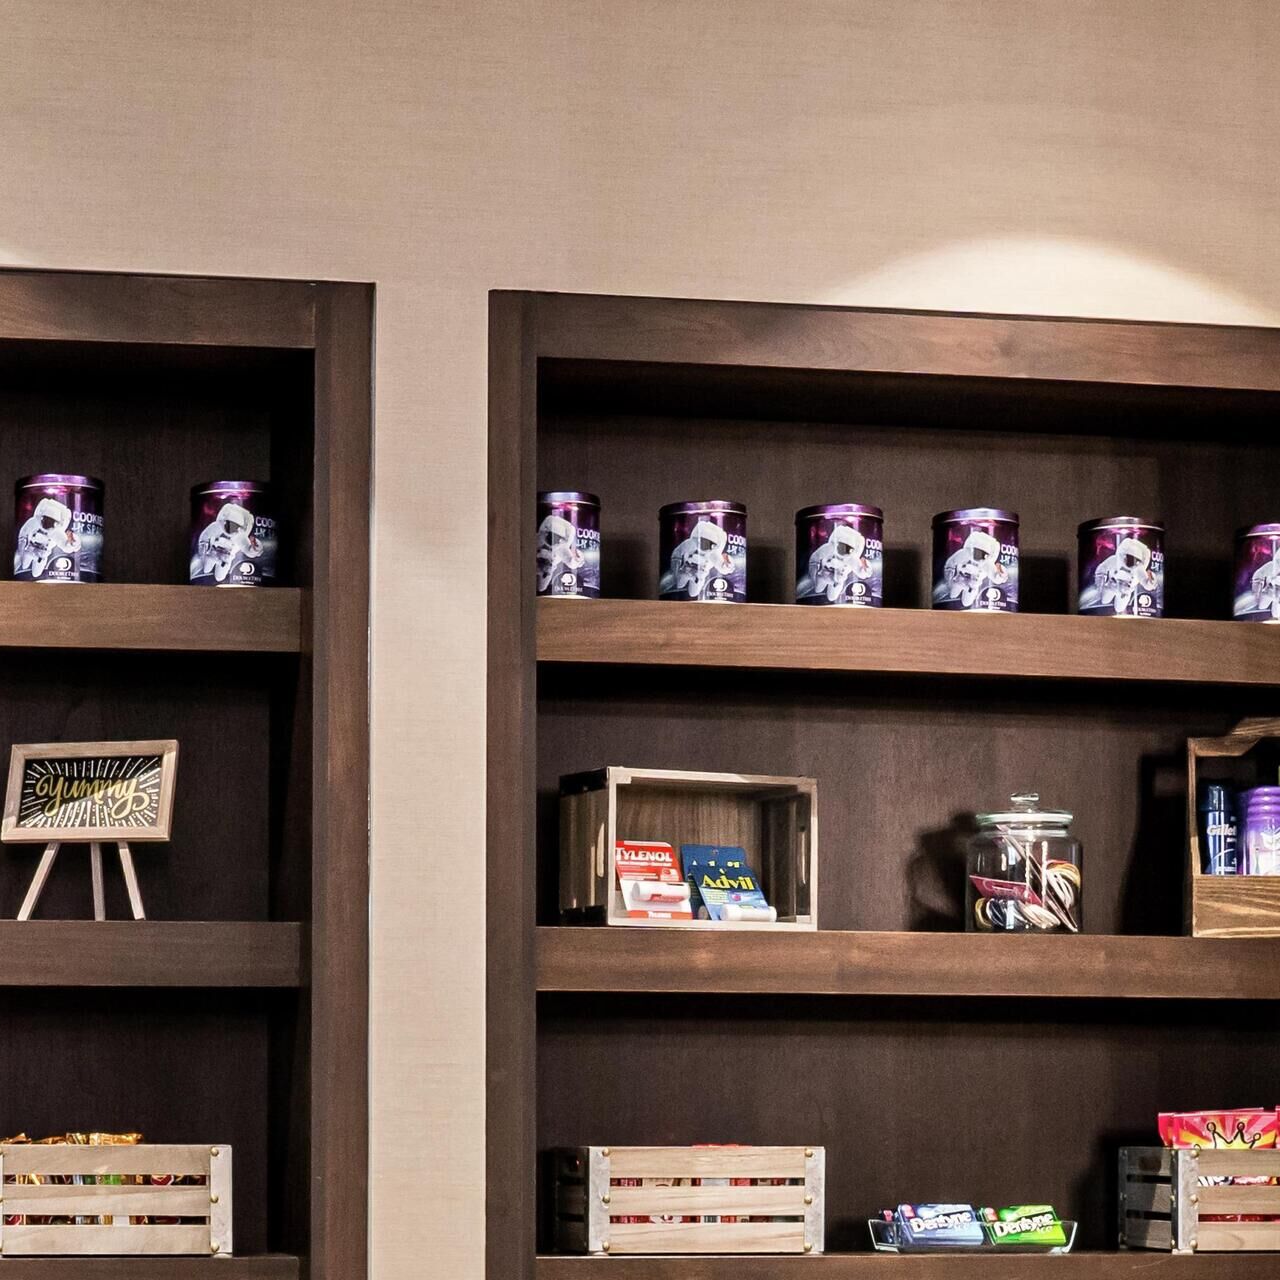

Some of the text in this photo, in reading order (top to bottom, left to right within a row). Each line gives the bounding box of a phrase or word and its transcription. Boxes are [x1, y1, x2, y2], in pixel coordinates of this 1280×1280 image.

[35, 774, 151, 819] yummy
[615, 847, 673, 862] TYLENOL
[702, 874, 755, 890] Advil
